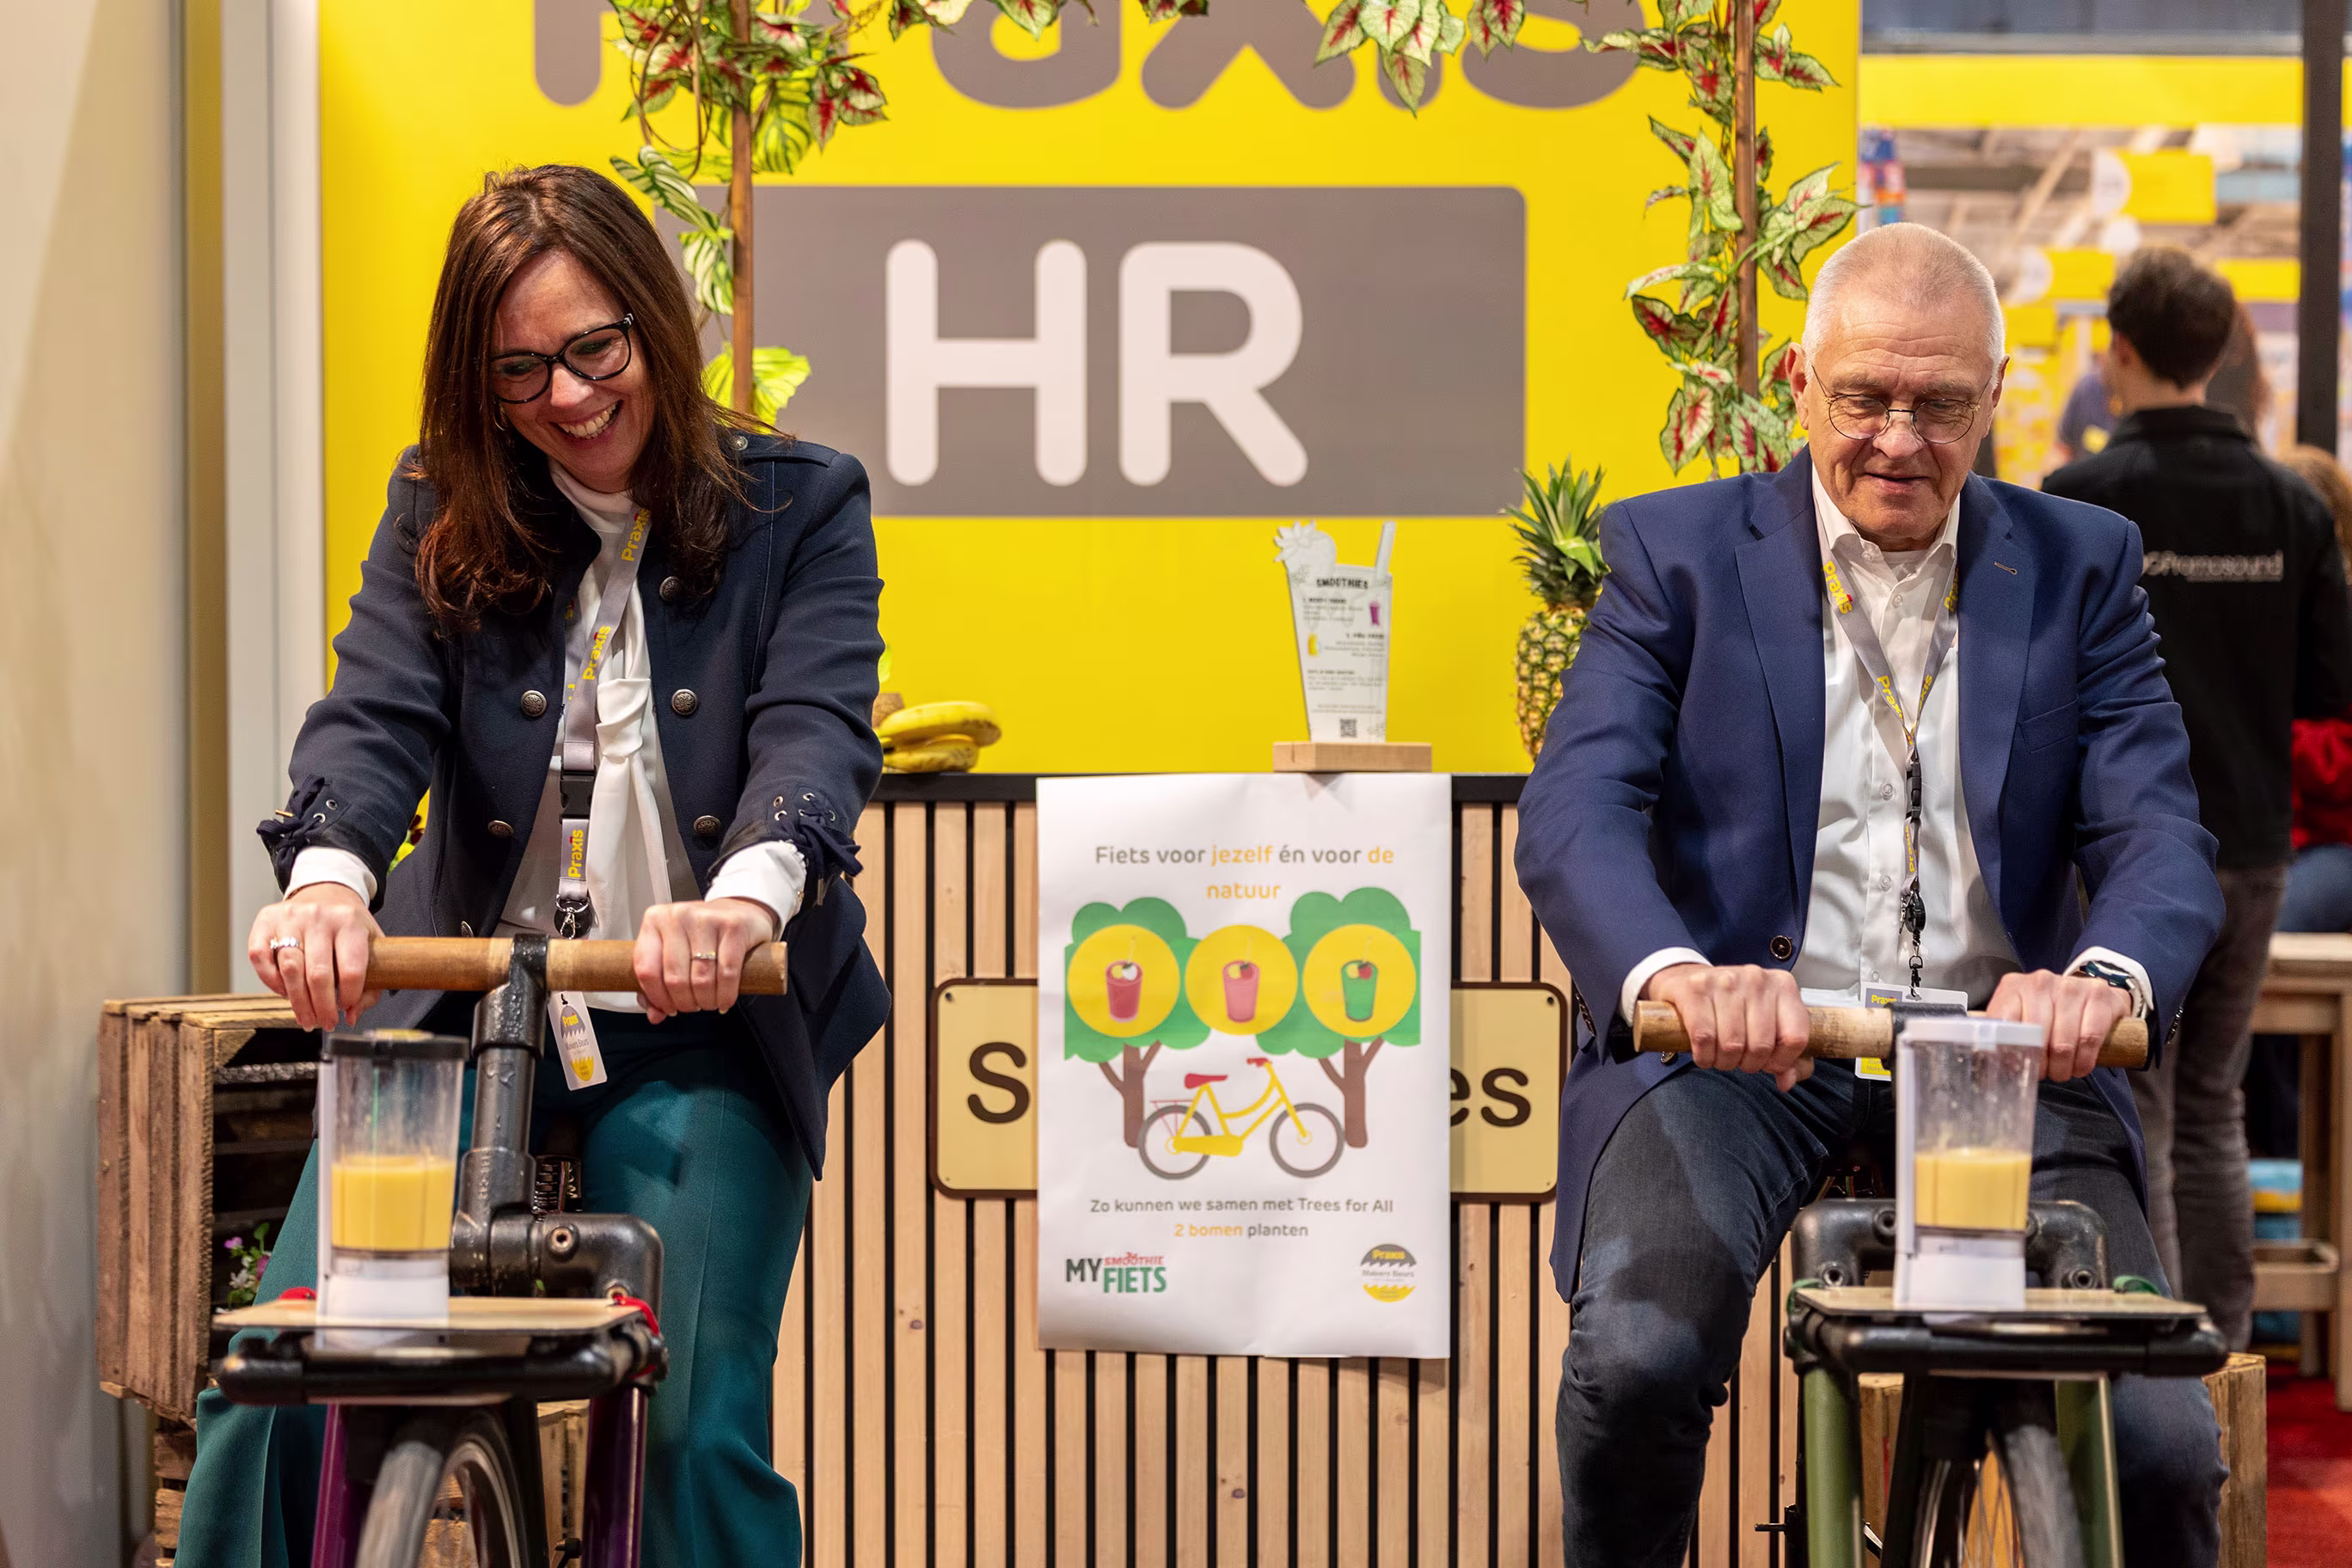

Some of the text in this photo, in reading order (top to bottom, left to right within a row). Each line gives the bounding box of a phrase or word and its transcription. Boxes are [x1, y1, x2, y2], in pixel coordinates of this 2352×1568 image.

[885, 239, 1309, 487] HR
[621, 508, 652, 561] Praxis
[1316, 578, 1369, 590] SMOOTHIES
[1822, 560, 1853, 614] Praxis
[582, 626, 611, 681] Praxis
[568, 830, 584, 878] Praxis
[1095, 845, 1394, 867] Fiets voor jezelf én voor de
[1206, 882, 1281, 899] natuur
[1090, 1197, 1393, 1213] Zo kunnen we samen met Trees for All
[1174, 1223, 1308, 1238] 2 bomen planten
[1066, 1253, 1165, 1282] MY SMOOTHIE
[1103, 1266, 1167, 1293] FIETS
